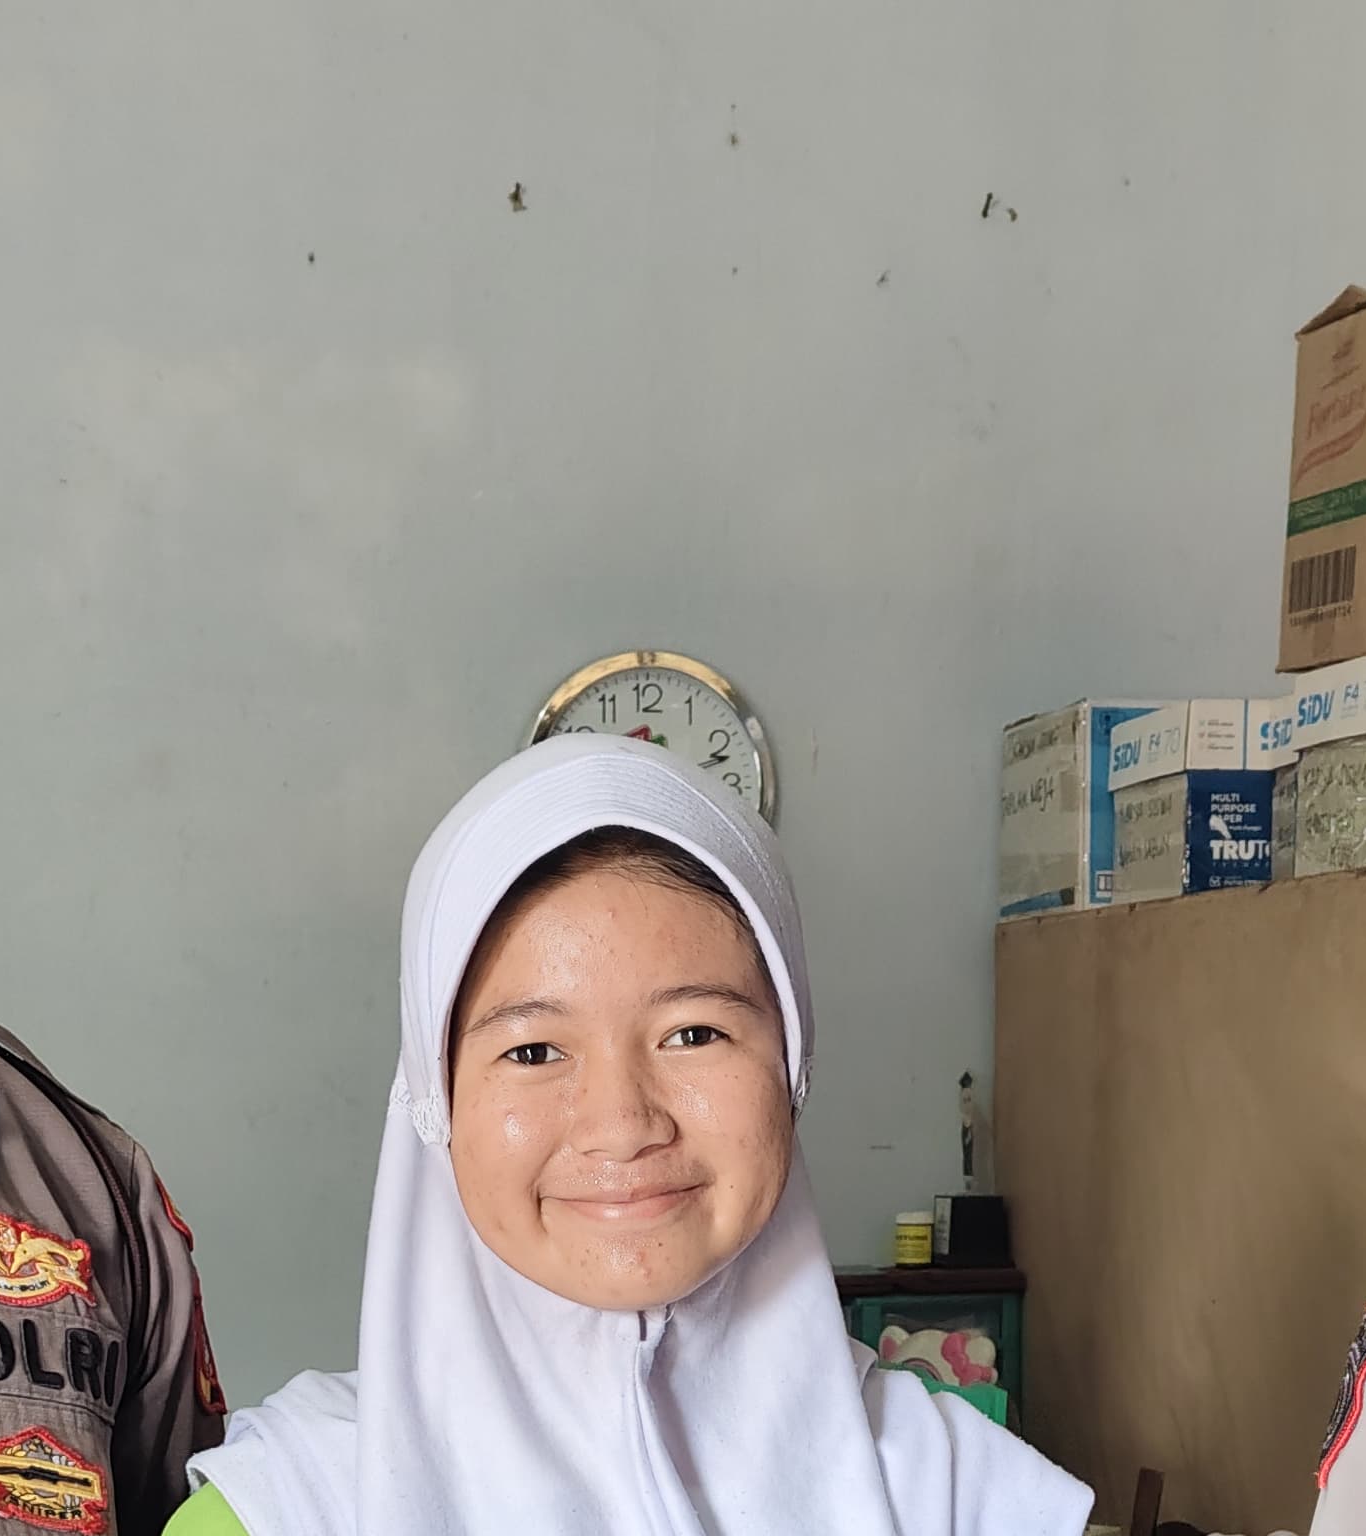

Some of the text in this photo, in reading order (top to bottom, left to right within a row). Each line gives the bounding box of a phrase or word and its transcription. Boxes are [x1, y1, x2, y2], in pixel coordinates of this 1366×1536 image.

[632, 683, 663, 713] 12
[1343, 683, 1360, 703] F4
[598, 694, 616, 723] 11
[684, 695, 693, 726] 1
[1210, 793, 1240, 802] MULTI
[1210, 803, 1257, 813] PURPOSE
[10, 1495, 82, 1520] SNIPER
